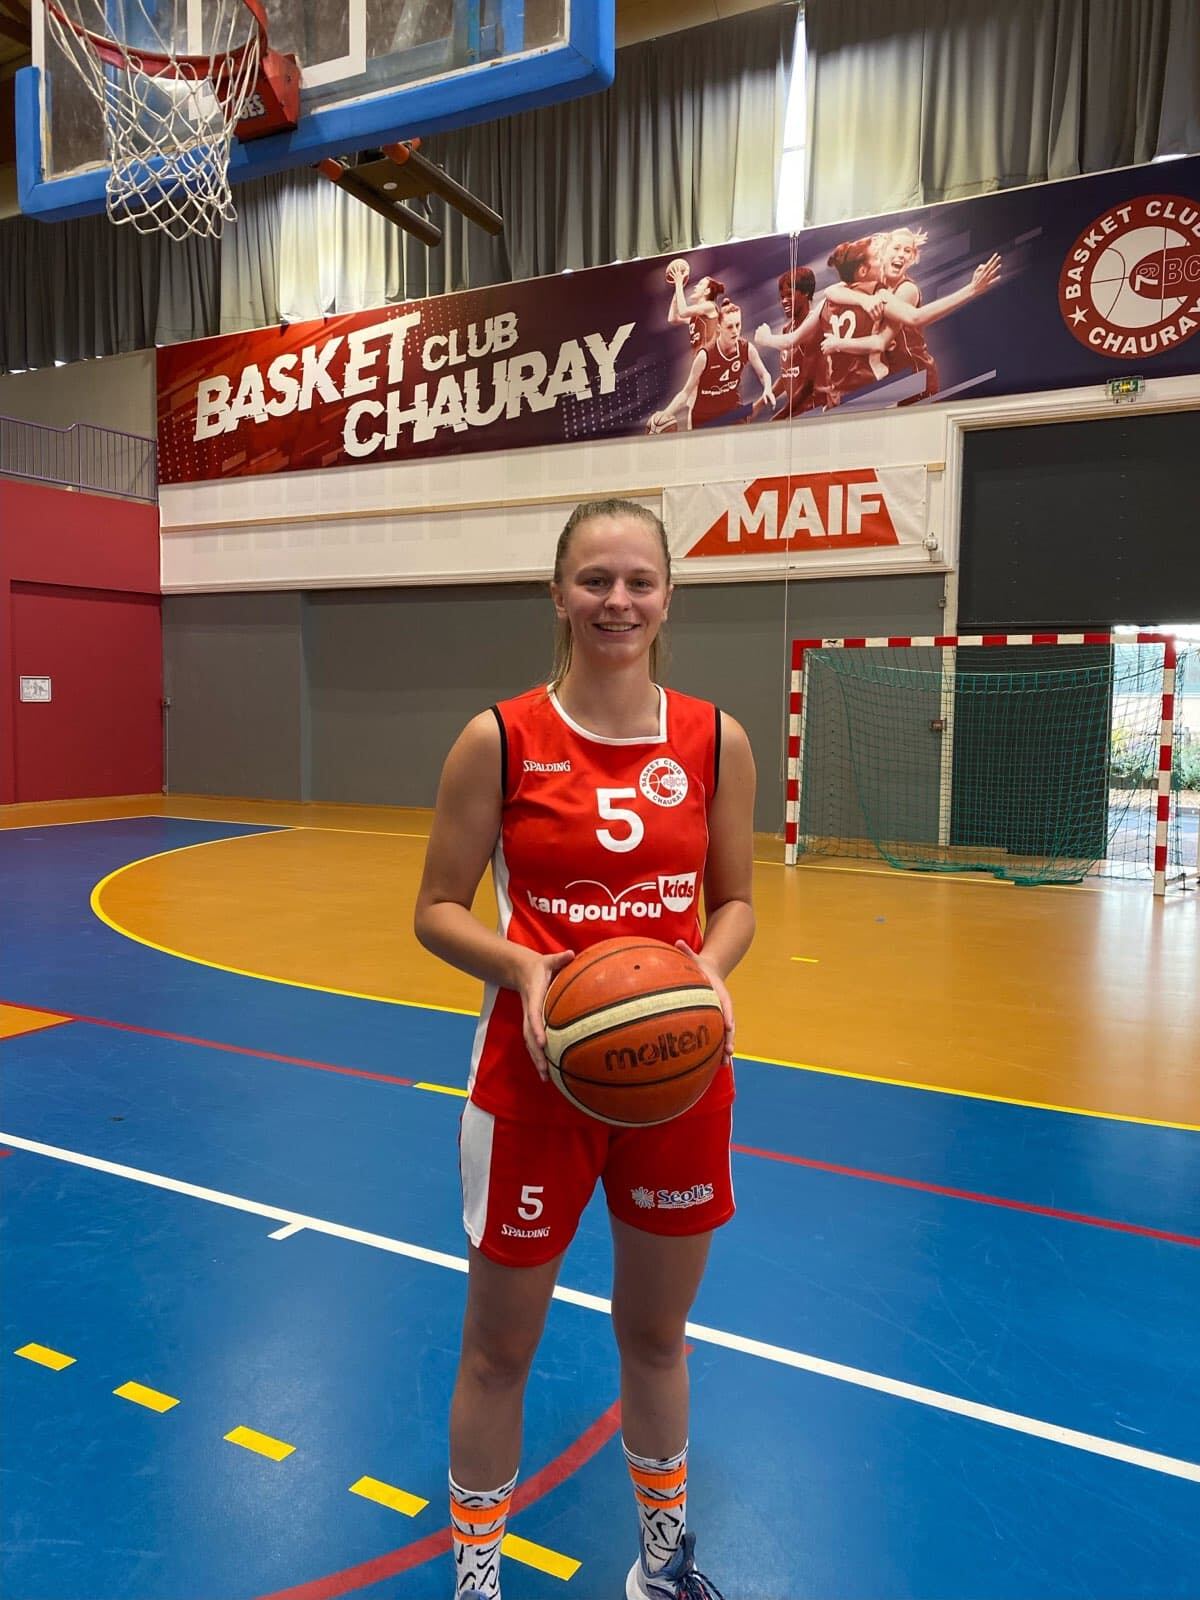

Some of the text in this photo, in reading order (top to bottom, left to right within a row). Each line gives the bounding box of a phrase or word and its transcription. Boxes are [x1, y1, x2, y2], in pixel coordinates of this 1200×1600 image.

[1065, 206, 1132, 300] BASKET
[191, 311, 519, 442] BASKET CLUB
[341, 321, 636, 458] CHAURAY
[719, 368, 730, 382] 4
[727, 481, 882, 543] MAIF
[523, 760, 571, 773] SPALDING
[641, 759, 683, 788] BASKET CLUB
[595, 787, 645, 853] 5
[652, 791, 684, 805] CHAURAY
[526, 879, 694, 923] kangourou kids
[603, 1024, 712, 1072] molten
[517, 1184, 545, 1221] 5
[500, 1223, 552, 1239] SPALDING
